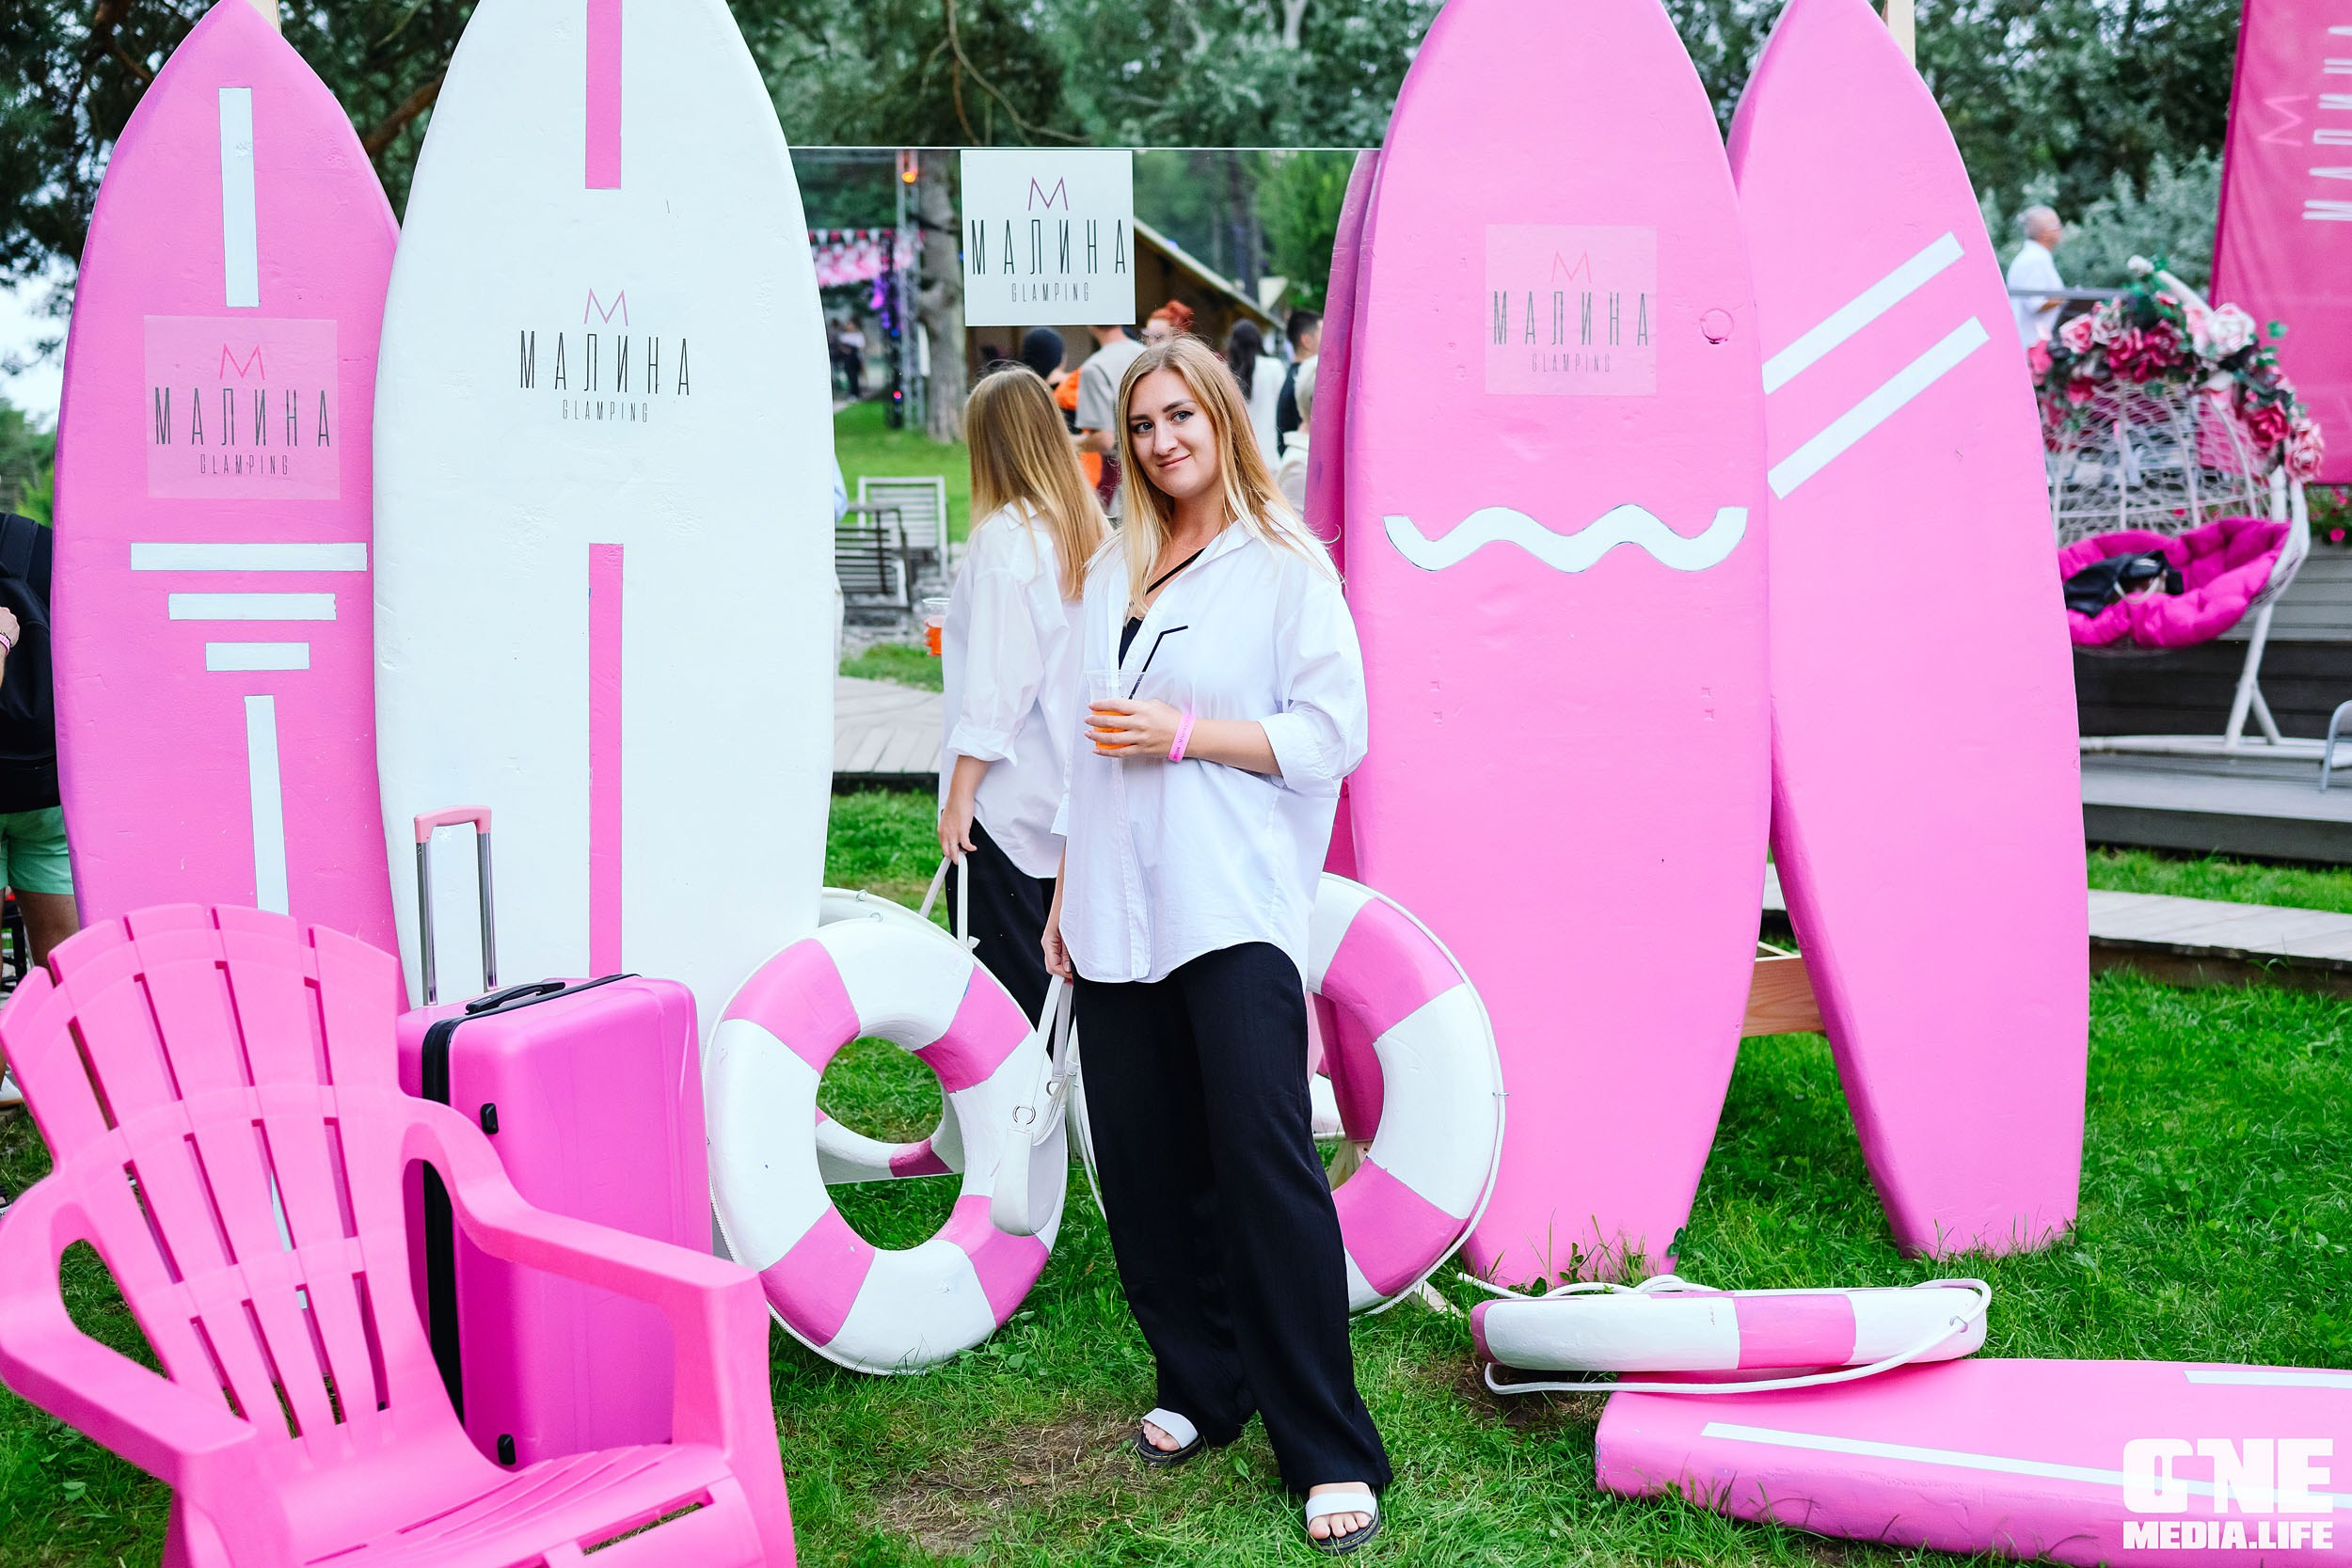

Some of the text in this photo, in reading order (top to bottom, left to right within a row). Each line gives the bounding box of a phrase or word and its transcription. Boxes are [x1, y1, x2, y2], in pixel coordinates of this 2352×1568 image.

[971, 219, 1126, 275] МАЛИНА
[1011, 282, 1089, 302] GLAMPING
[1493, 291, 1648, 346] МАЛИНА
[520, 330, 690, 396] МАЛИНА
[1532, 353, 1610, 372] GLAMPING
[154, 387, 330, 447] МАЛИНА
[563, 399, 648, 423] GLAMPING
[200, 454, 288, 475] GLAMPING
